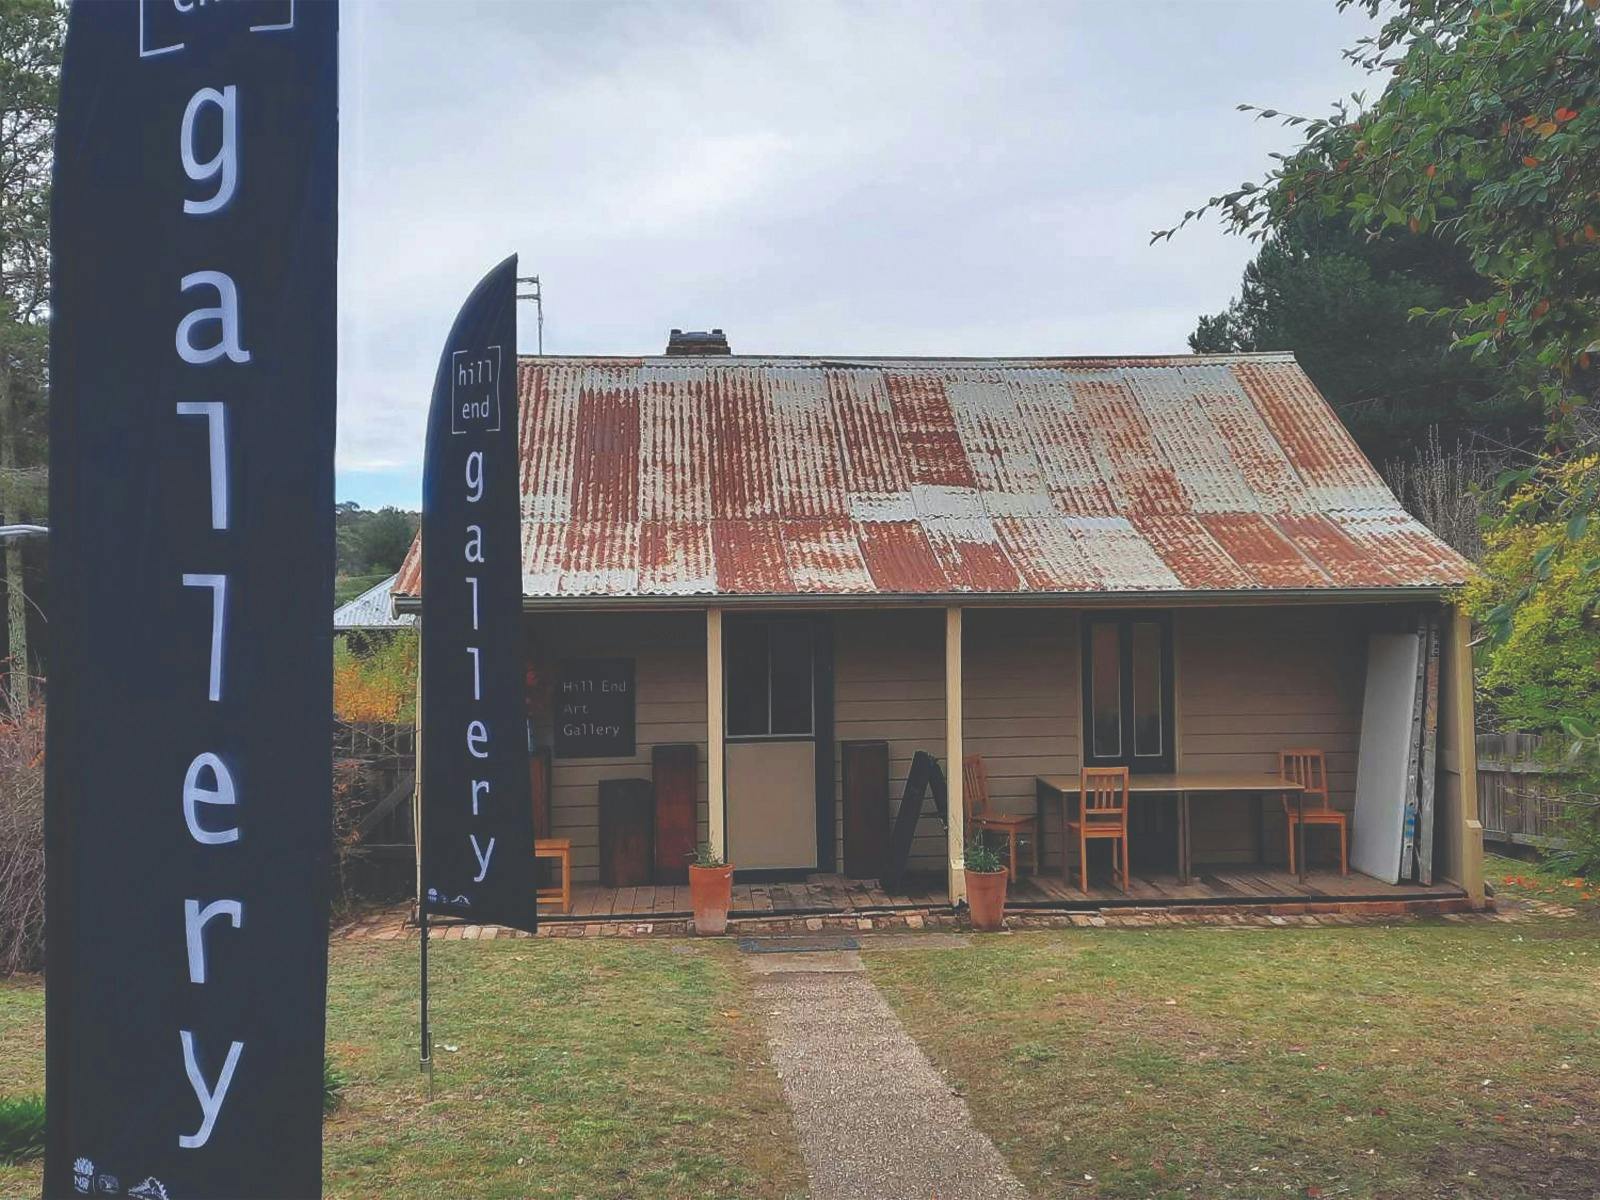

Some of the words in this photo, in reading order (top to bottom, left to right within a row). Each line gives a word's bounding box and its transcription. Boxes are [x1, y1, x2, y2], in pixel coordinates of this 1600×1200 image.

[458, 359, 492, 386] hill
[462, 394, 490, 420] end
[176, 86, 250, 1149] gallery
[464, 450, 496, 884] gallery
[563, 680, 593, 693] Hill
[602, 680, 626, 693] End
[563, 704, 589, 714] Art
[563, 723, 620, 737] Gallery
